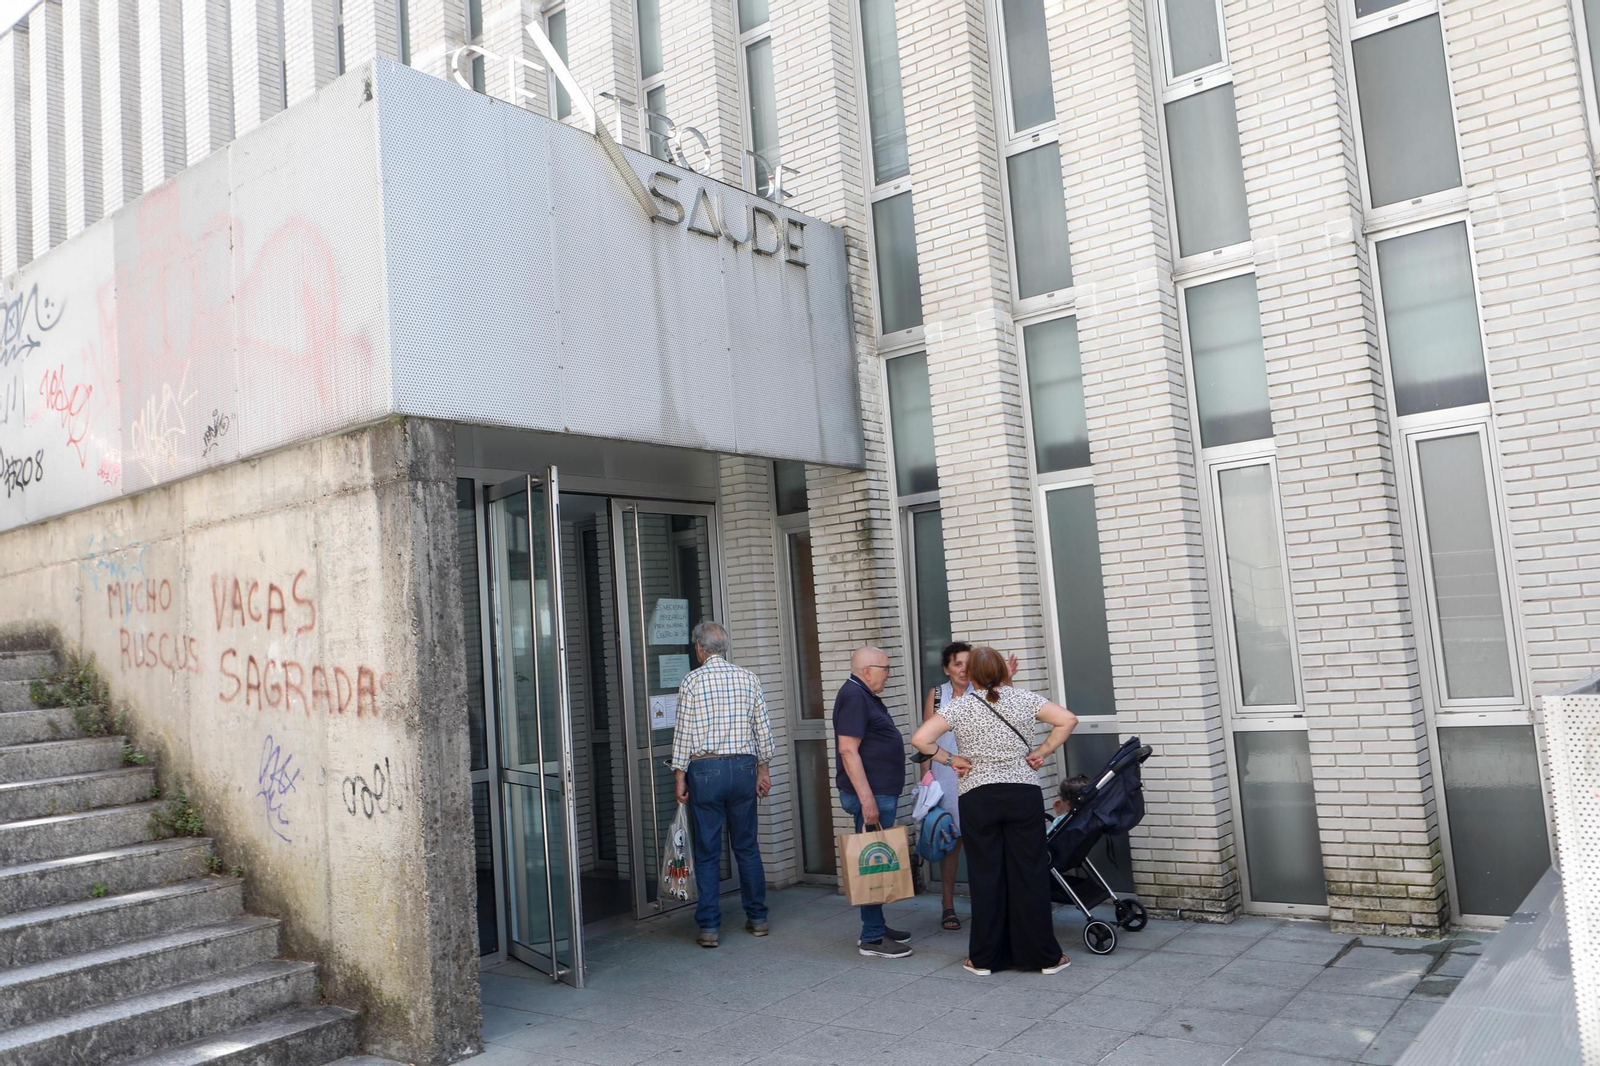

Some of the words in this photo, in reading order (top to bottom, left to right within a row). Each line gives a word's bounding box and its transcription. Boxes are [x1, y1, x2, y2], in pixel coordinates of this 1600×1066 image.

[741, 149, 802, 200] DE
[106, 578, 173, 620] MUCHO
[211, 568, 317, 635] VACAS
